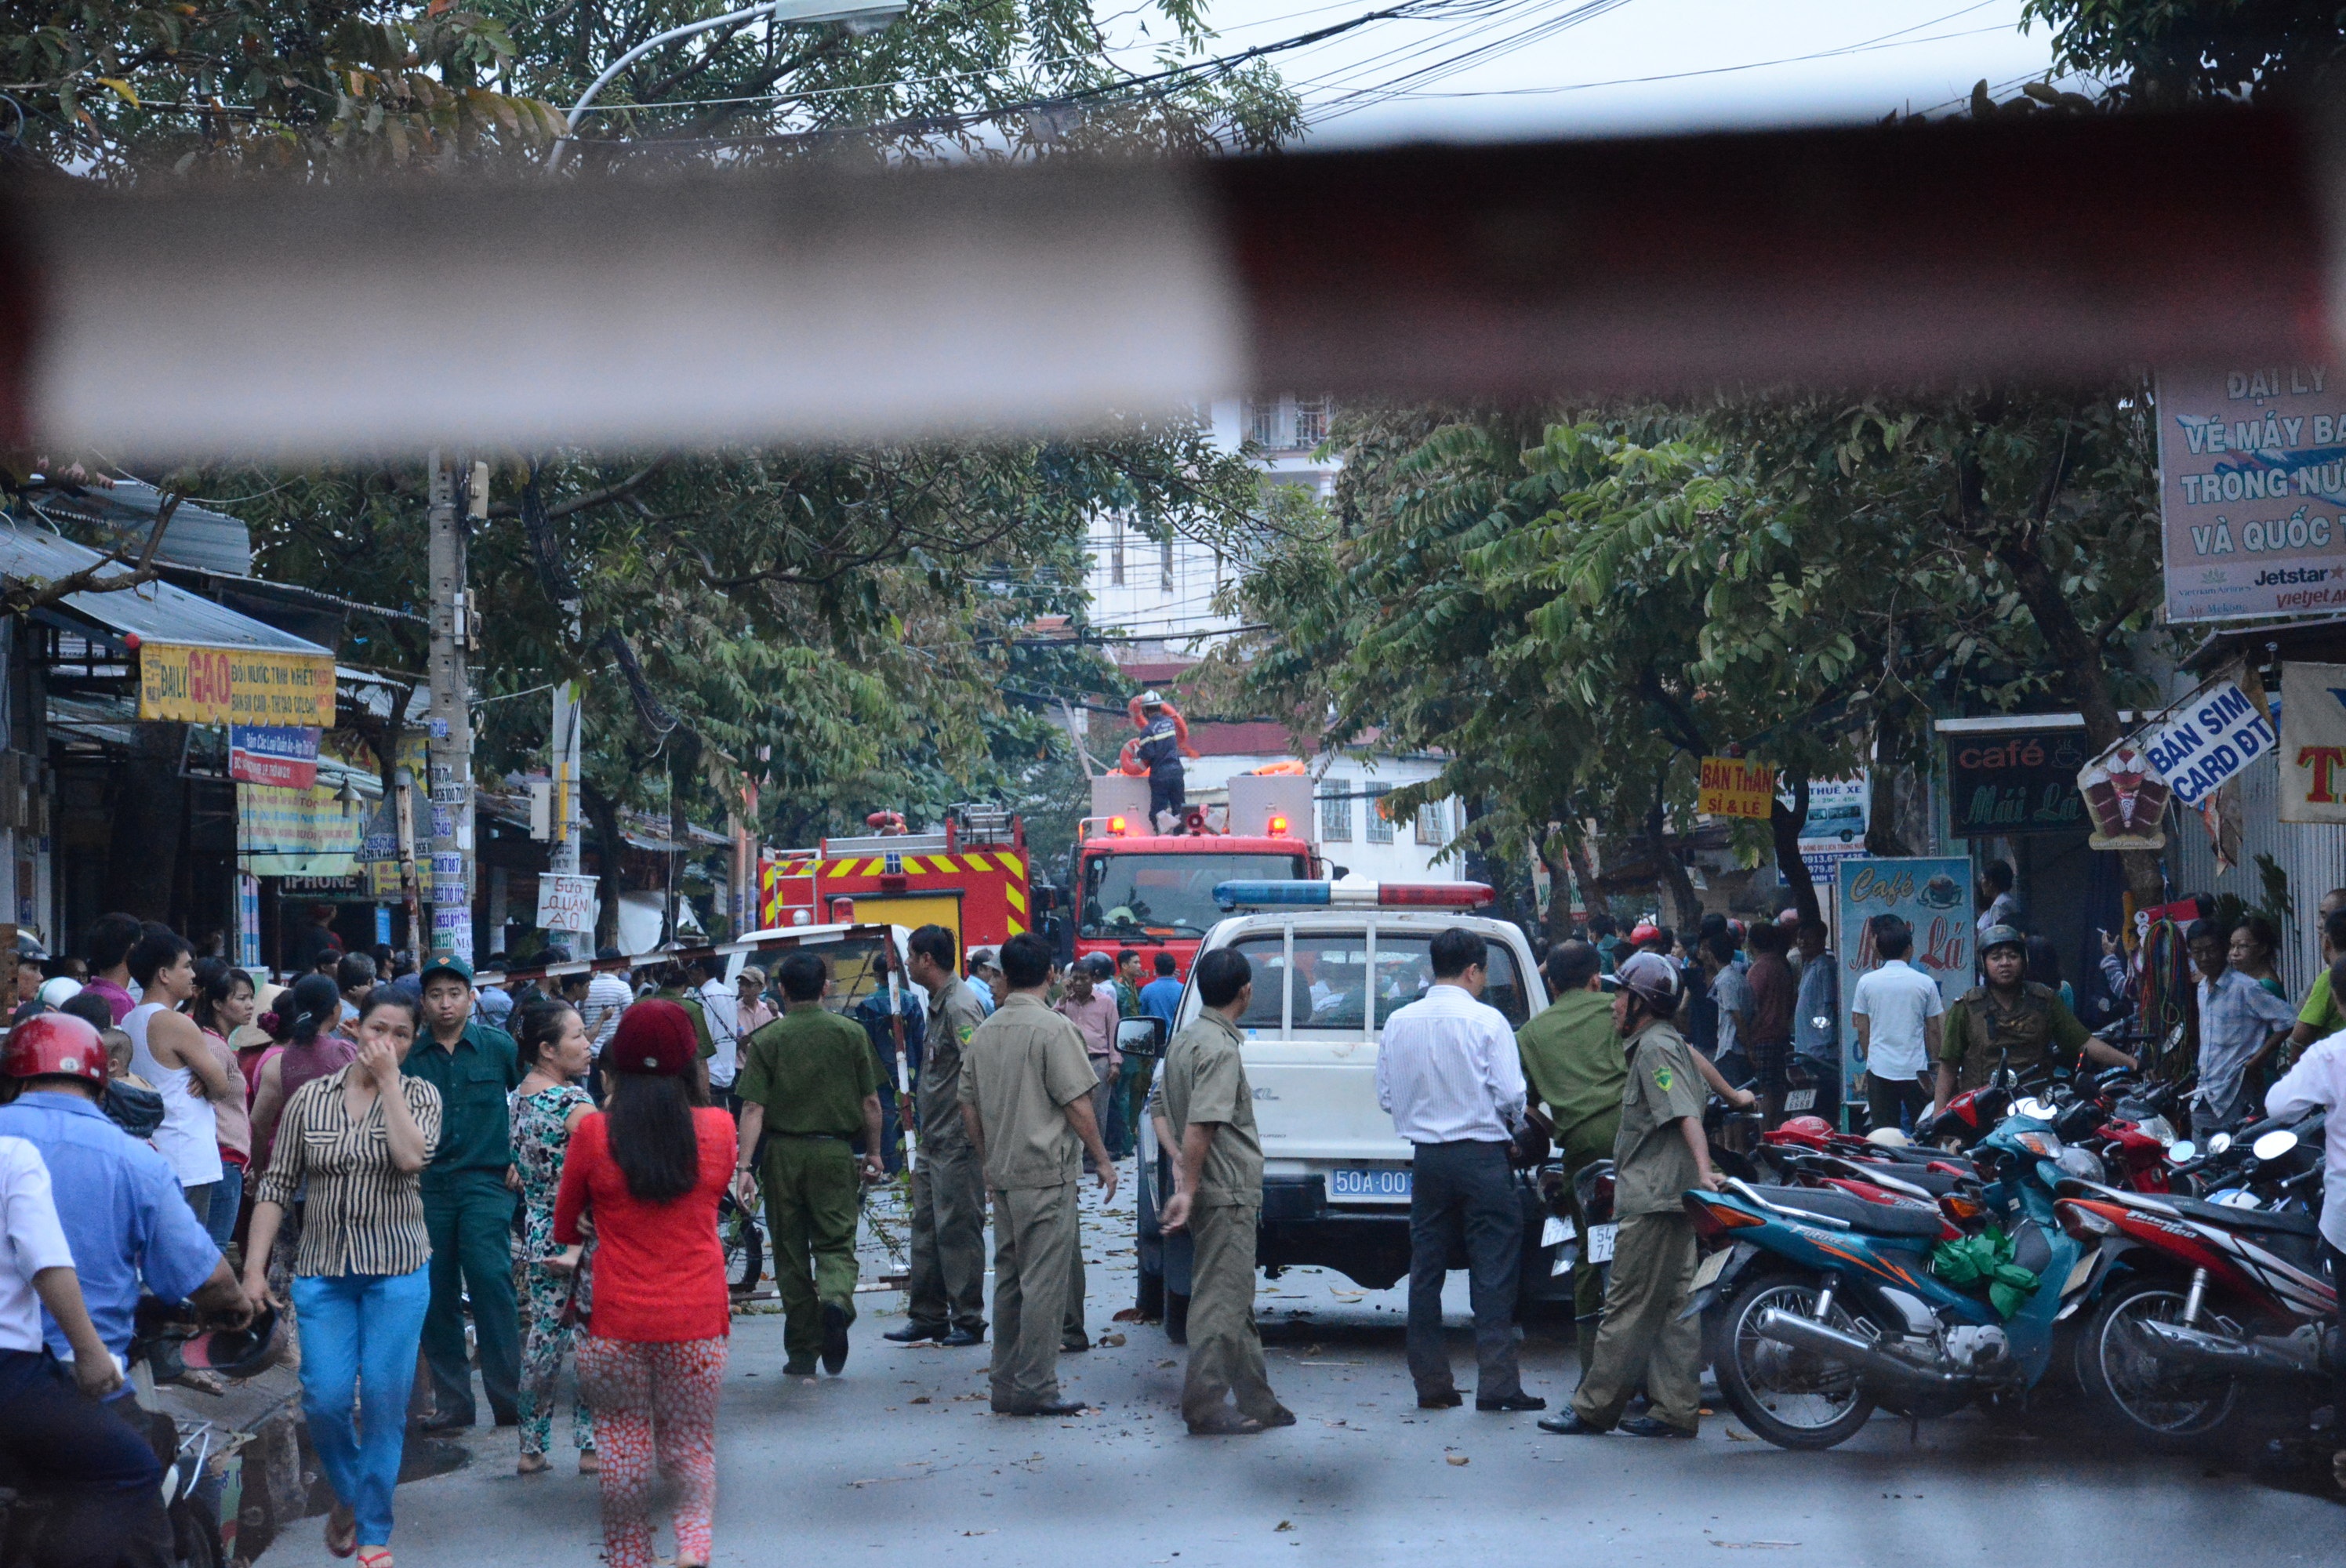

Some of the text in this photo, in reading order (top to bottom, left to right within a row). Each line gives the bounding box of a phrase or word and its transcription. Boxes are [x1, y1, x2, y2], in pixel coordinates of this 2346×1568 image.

[2235, 409, 2304, 452] MÁY
[2181, 459, 2346, 505] TRONG NƯ
[2190, 515, 2235, 555] VÀ
[2242, 504, 2331, 553] QUỐC
[2253, 567, 2329, 586] Jetstar
[188, 651, 231, 715] GẠO
[2145, 686, 2251, 775] BÁN SIM
[1959, 739, 2046, 769] café
[2172, 715, 2274, 803] CARD ĐT
[1702, 759, 1731, 790] BÁN
[1810, 784, 1842, 796] THUÊ
[1727, 800, 1737, 813] &
[285, 875, 357, 890] IPHONE
[1849, 867, 1914, 907] Café
[1919, 916, 1966, 971] Lá
[1335, 1171, 1412, 1194] 50A-00
